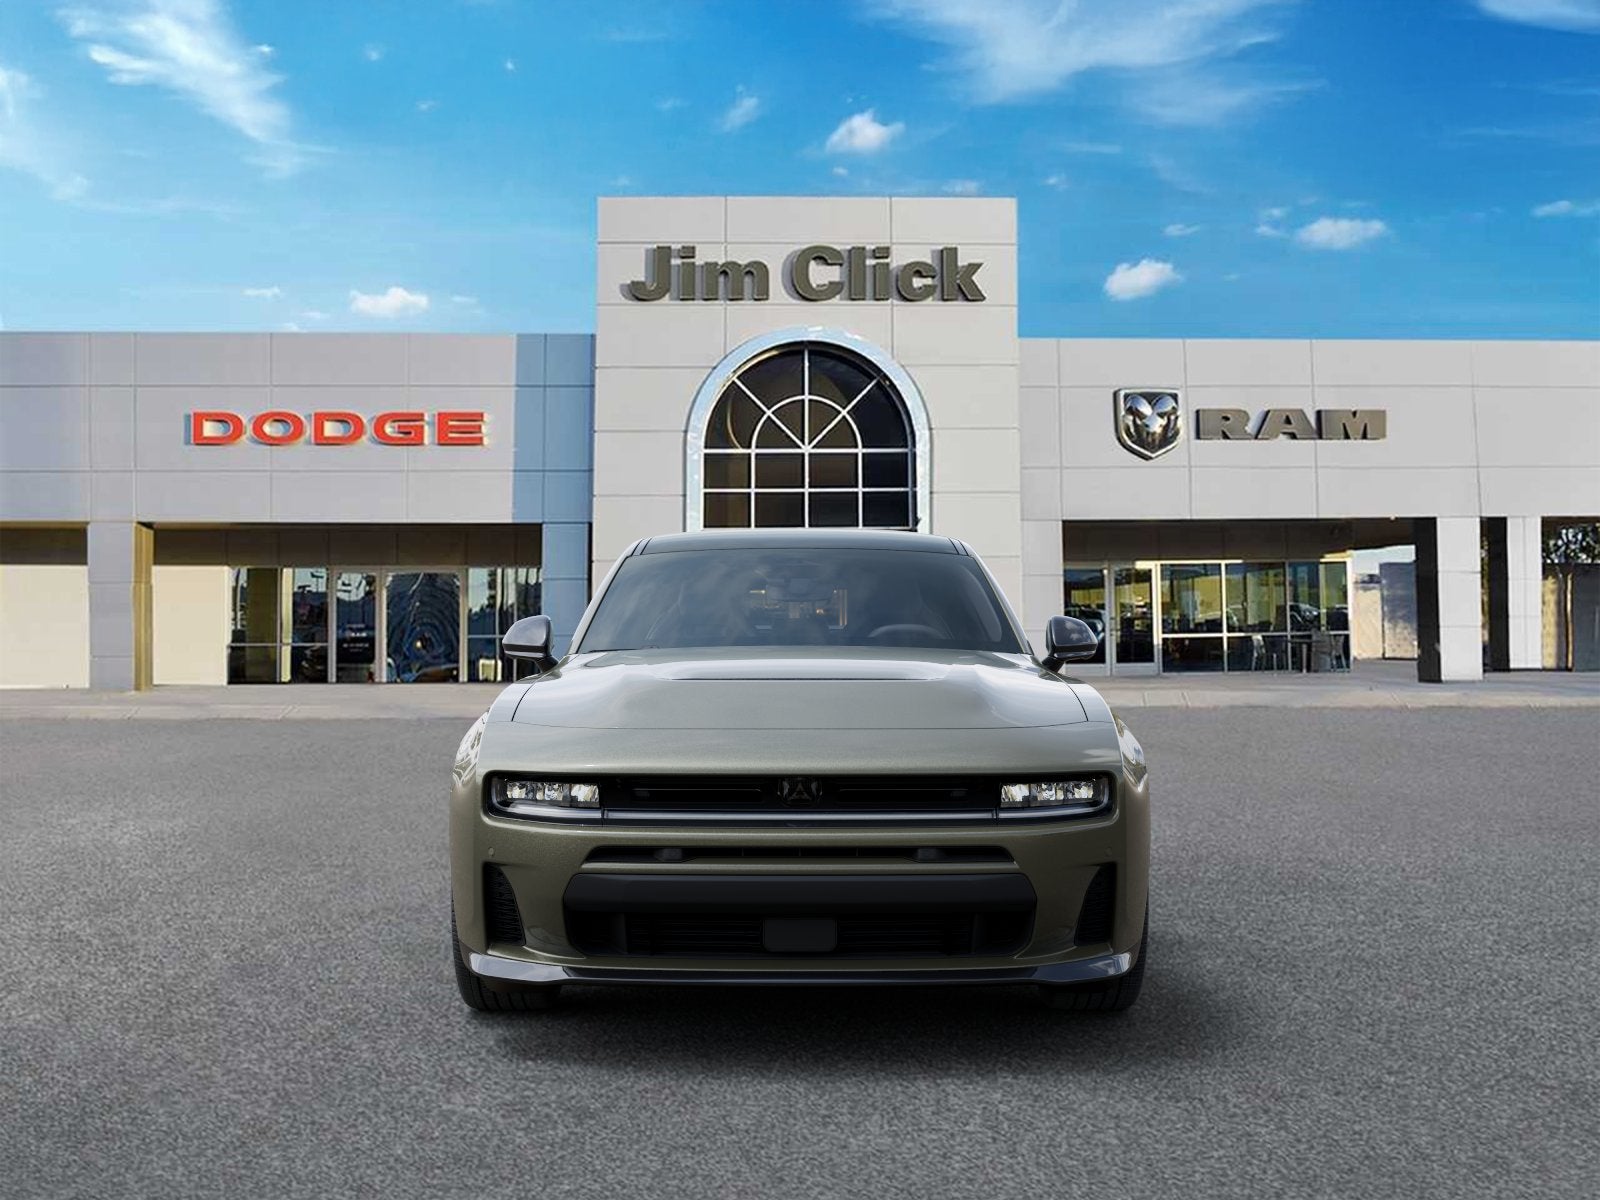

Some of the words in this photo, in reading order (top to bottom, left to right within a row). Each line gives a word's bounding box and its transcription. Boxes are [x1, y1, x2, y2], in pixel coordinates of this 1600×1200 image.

[629, 244, 770, 301] Jim
[792, 244, 986, 301] Click
[190, 411, 487, 446] DODGE
[1196, 408, 1387, 440] RAM
